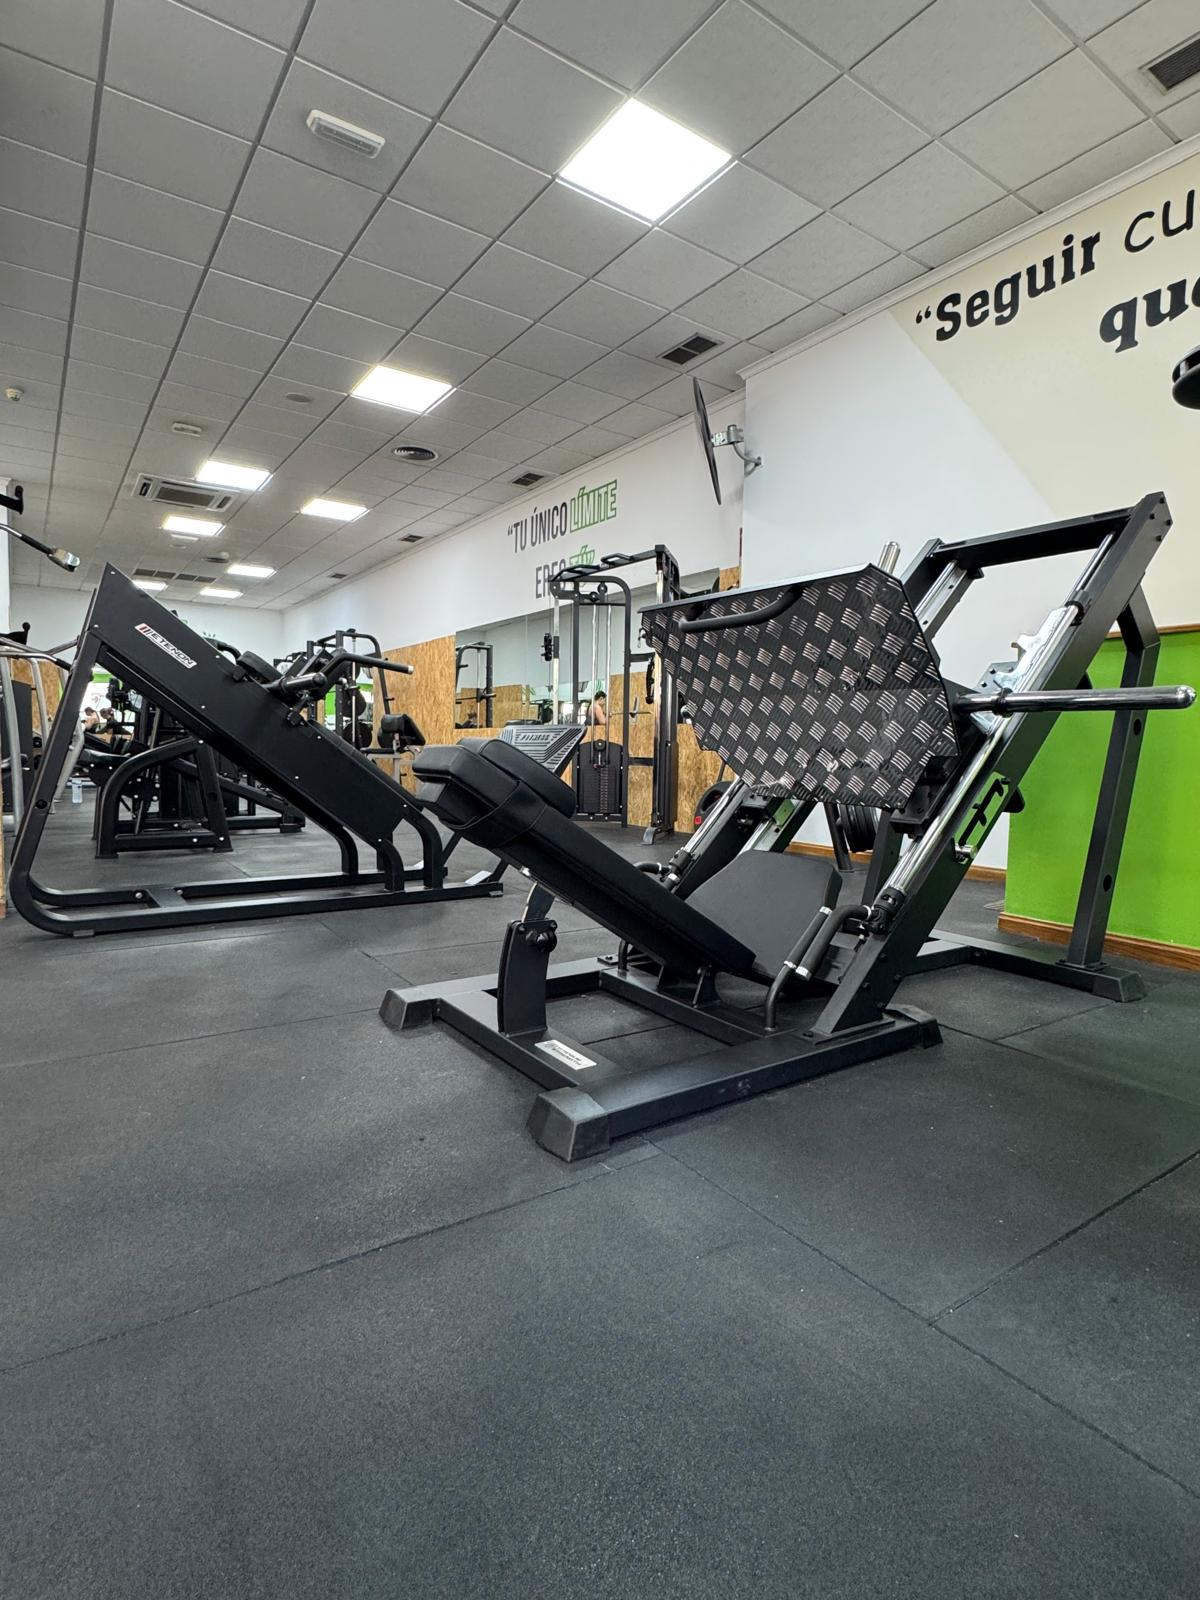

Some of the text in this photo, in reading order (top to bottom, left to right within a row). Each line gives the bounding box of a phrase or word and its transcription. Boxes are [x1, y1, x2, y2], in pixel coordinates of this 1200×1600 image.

[915, 232, 1100, 342] “Seguir
[530, 501, 568, 547] ÚNICO
[570, 480, 618, 533] LÍMITE
